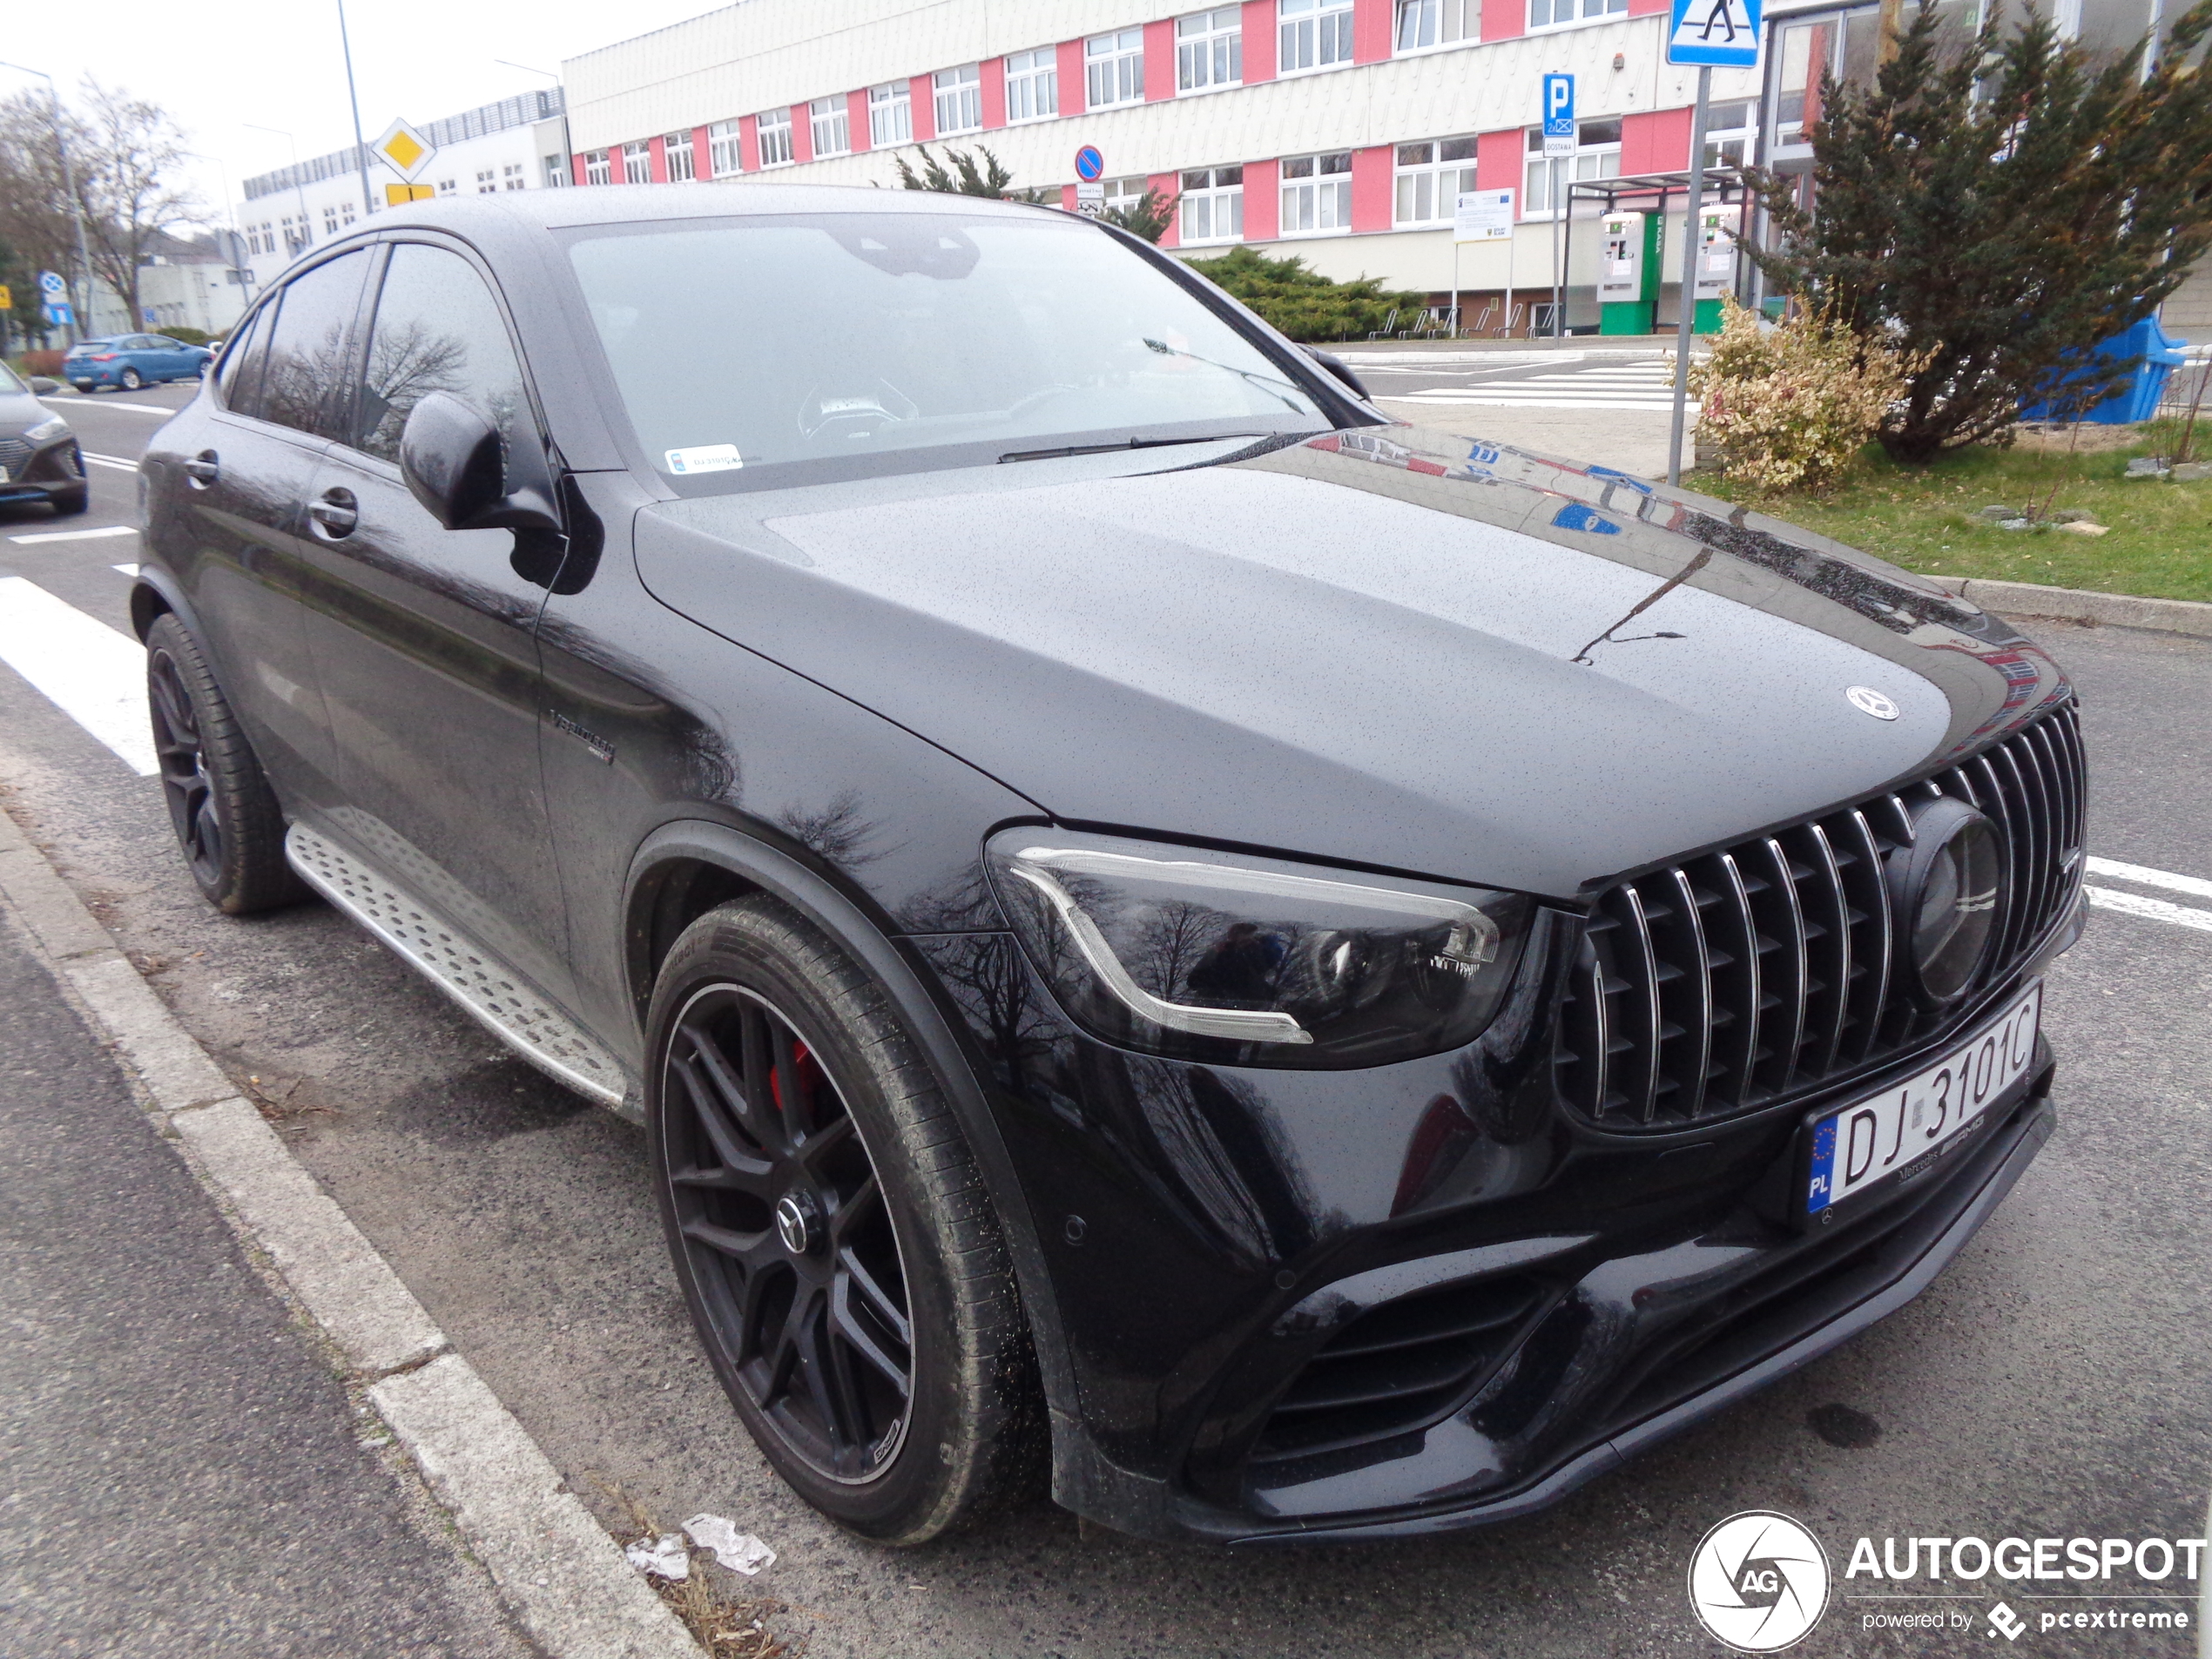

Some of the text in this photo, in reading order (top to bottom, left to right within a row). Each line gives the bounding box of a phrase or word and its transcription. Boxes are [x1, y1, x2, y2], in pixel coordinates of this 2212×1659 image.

[1550, 78, 1569, 118] P
[1844, 1003, 2030, 1187] DJ 3101C
[1898, 1150, 1939, 1183] Mercedes
[1809, 1174, 1828, 1199] PL
